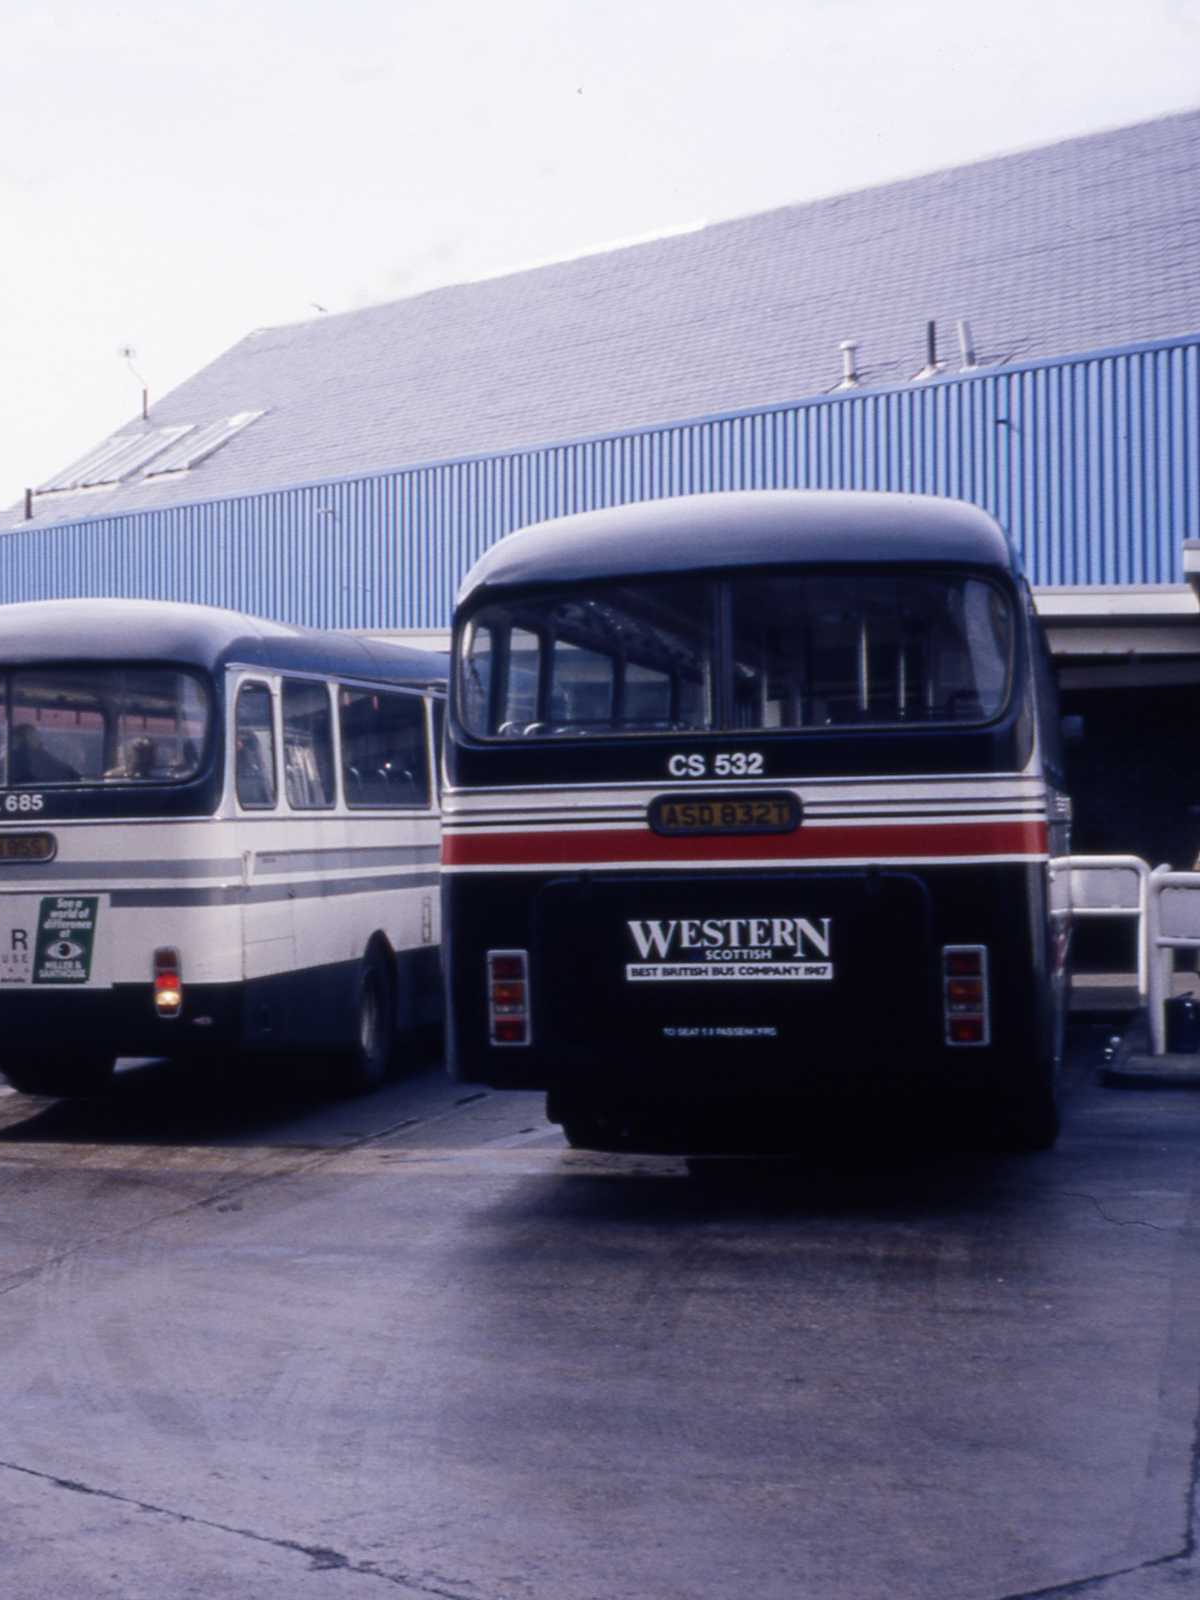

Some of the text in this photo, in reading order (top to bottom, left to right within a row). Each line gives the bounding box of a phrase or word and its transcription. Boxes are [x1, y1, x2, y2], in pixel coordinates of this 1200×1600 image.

[668, 752, 764, 776] CS 532
[5, 794, 44, 811] 685
[666, 805, 714, 826] ASD
[627, 917, 832, 959] WESTERN
[705, 949, 772, 961] SCOTTISH
[630, 966, 659, 977] BEST
[662, 966, 709, 977] BRITISH
[711, 966, 736, 977] BUS
[738, 965, 800, 976] COMPANY
